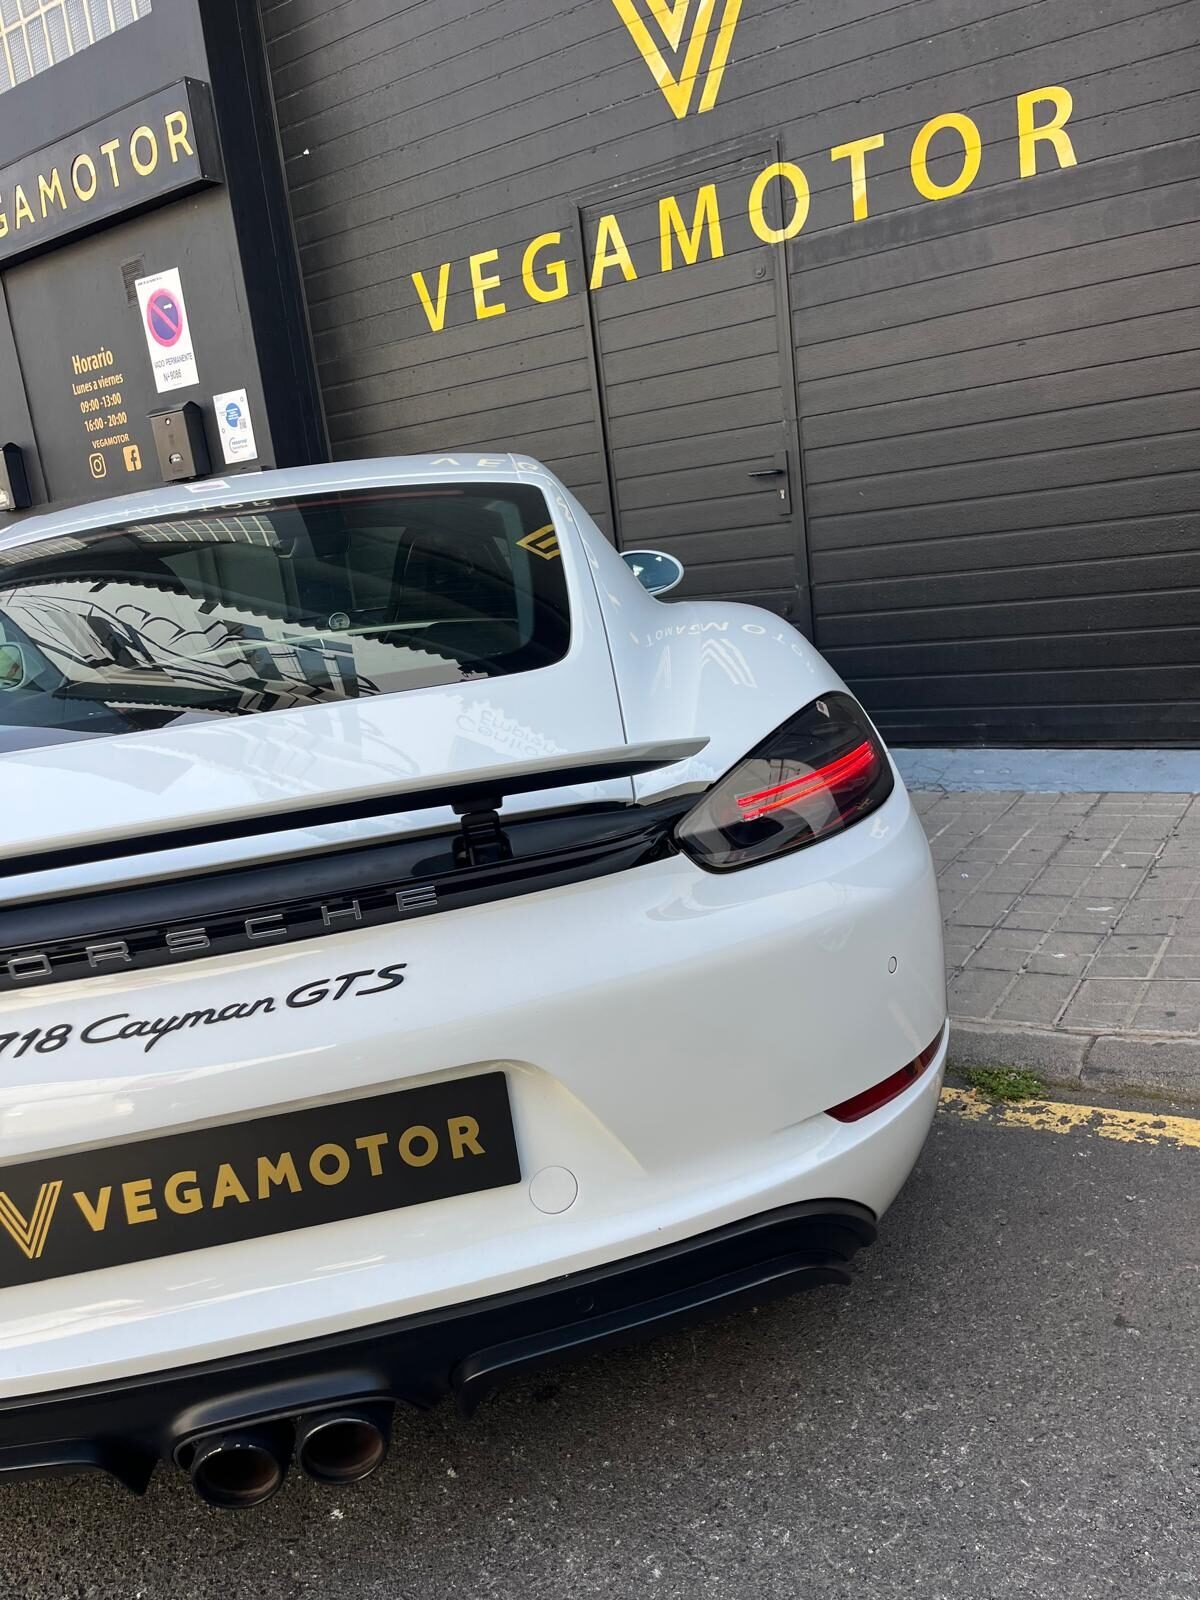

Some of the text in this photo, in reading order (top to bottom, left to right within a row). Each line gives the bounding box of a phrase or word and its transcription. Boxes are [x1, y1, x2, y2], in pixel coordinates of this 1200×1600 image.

[411, 85, 1079, 333] VEGAMOTOR
[72, 346, 114, 375] Horario
[72, 373, 124, 396] Lunes a viernes
[80, 399, 100, 414] 09:00
[84, 417, 104, 432] 16:00
[108, 412, 128, 427] 20:00
[91, 433, 130, 449] VEGAMOTOR
[0, 962, 408, 1059] 718 Cayman GTS
[73, 1115, 487, 1232] VEGAMOTOR
